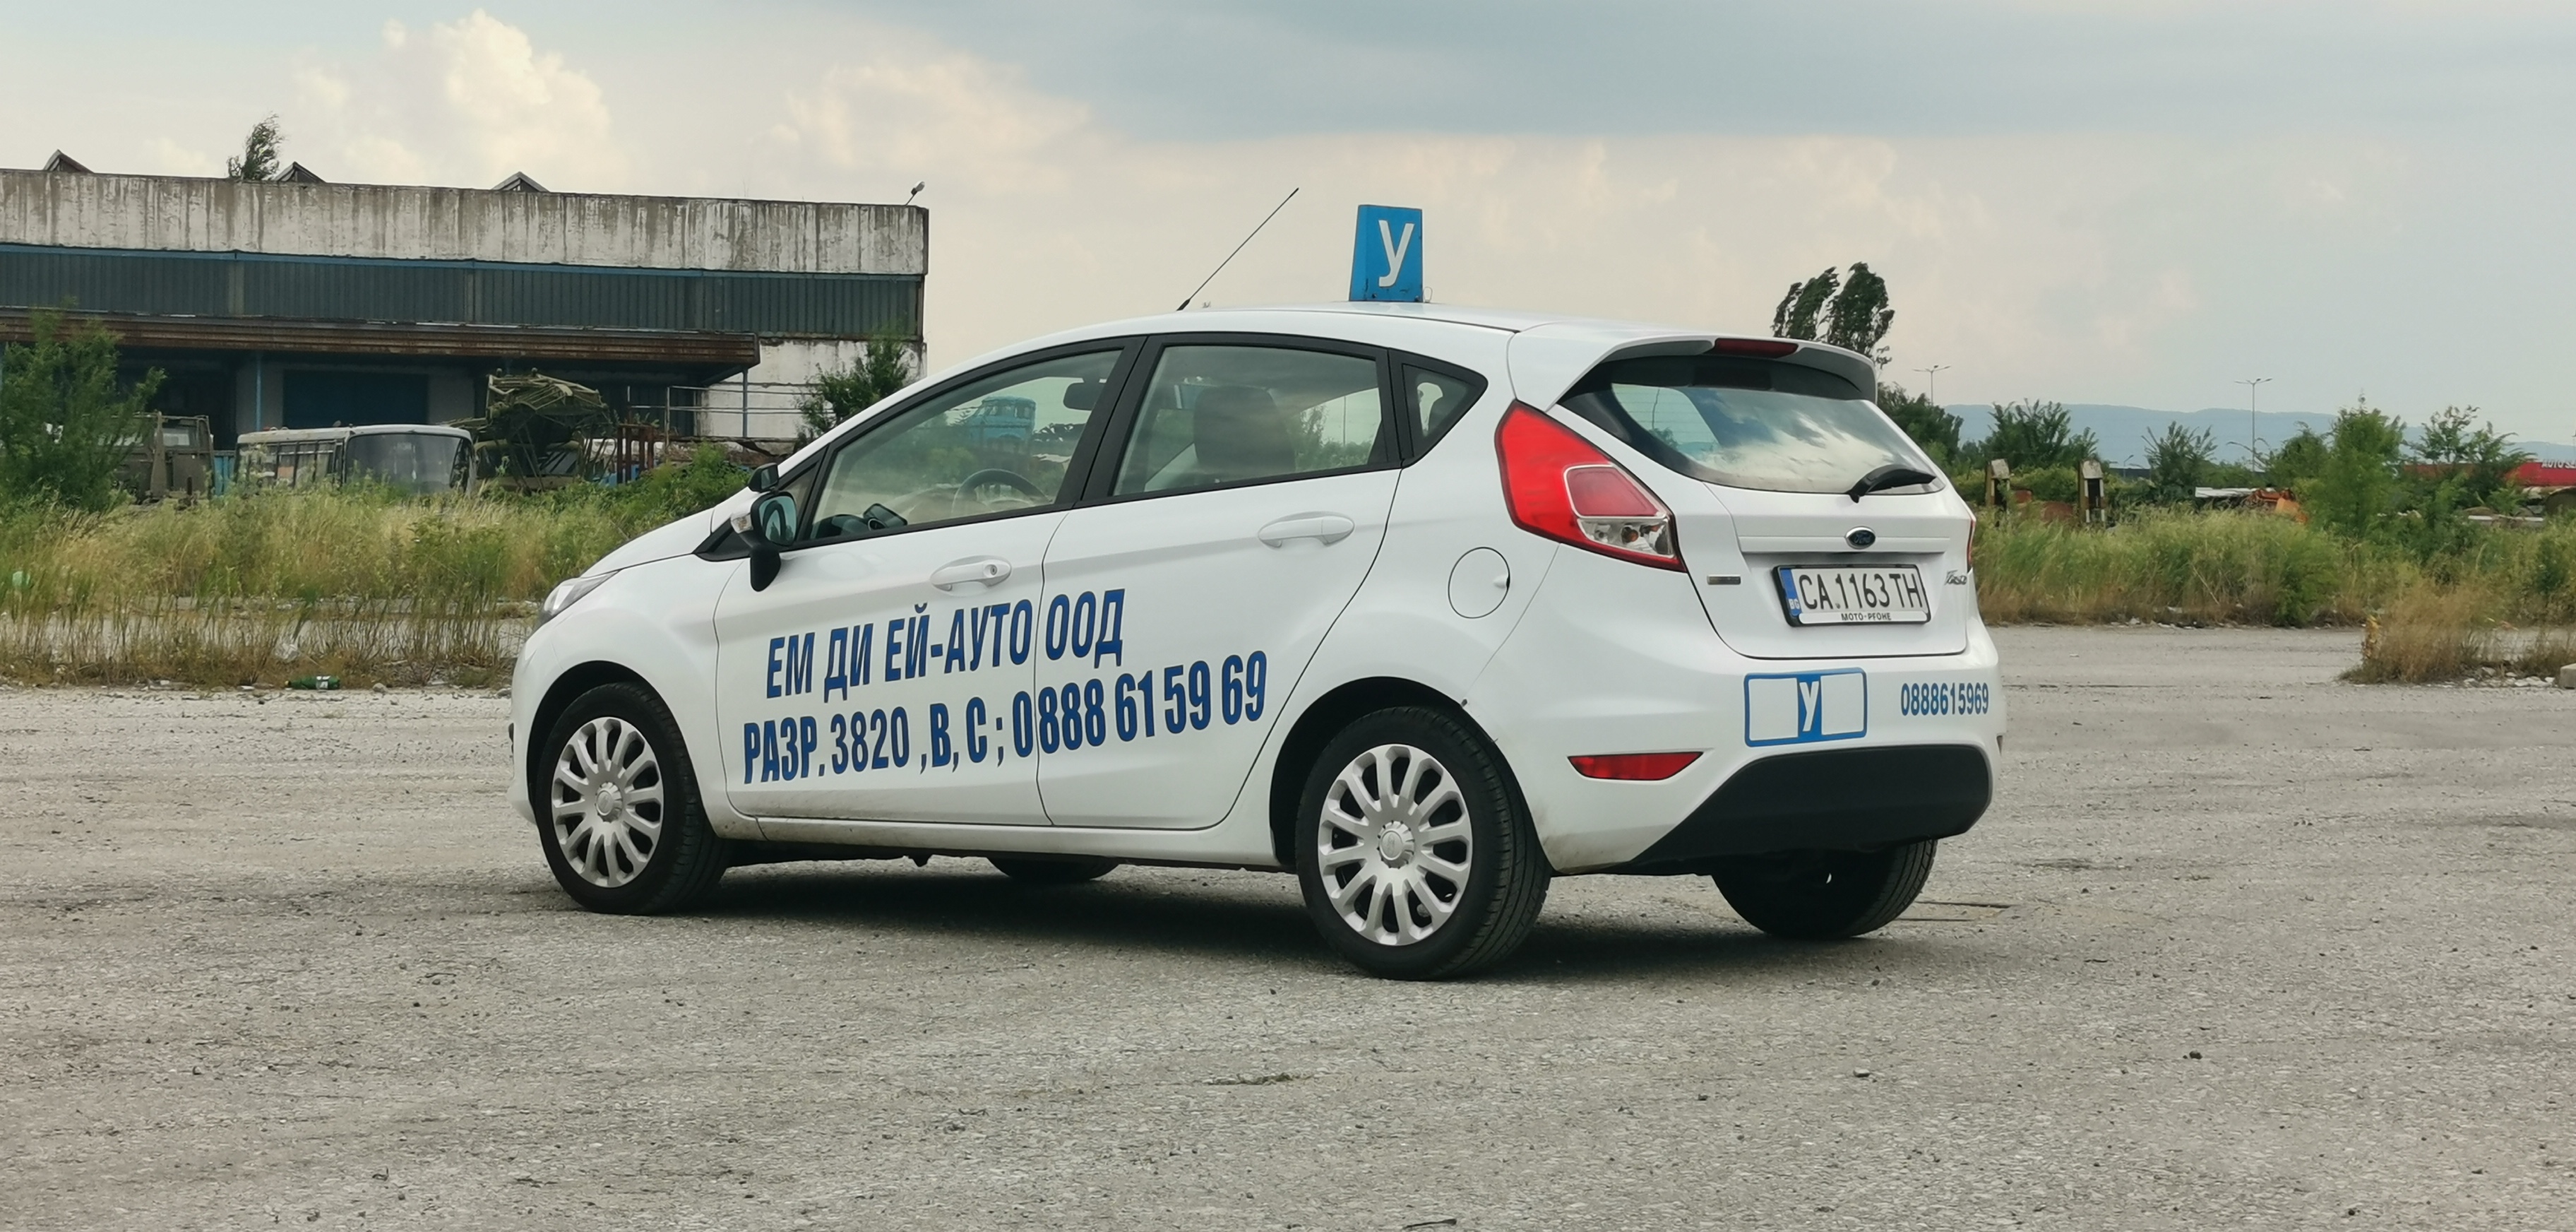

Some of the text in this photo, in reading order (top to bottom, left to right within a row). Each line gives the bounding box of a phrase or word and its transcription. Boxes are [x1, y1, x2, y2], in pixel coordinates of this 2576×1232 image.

[1378, 220, 1415, 288] У
[1788, 598, 1801, 610] BG
[767, 588, 1126, 703] ЕМ ДИ ЕЙ-АУТО ООД
[744, 716, 825, 783] РАЗР.
[831, 707, 910, 774] 3820
[1013, 679, 1107, 757] 0888
[1116, 669, 1155, 742] 61
[1164, 661, 1212, 735] 59
[1222, 651, 1268, 724] 69
[1799, 681, 1820, 732] У
[1901, 682, 1989, 716] 0888615969
